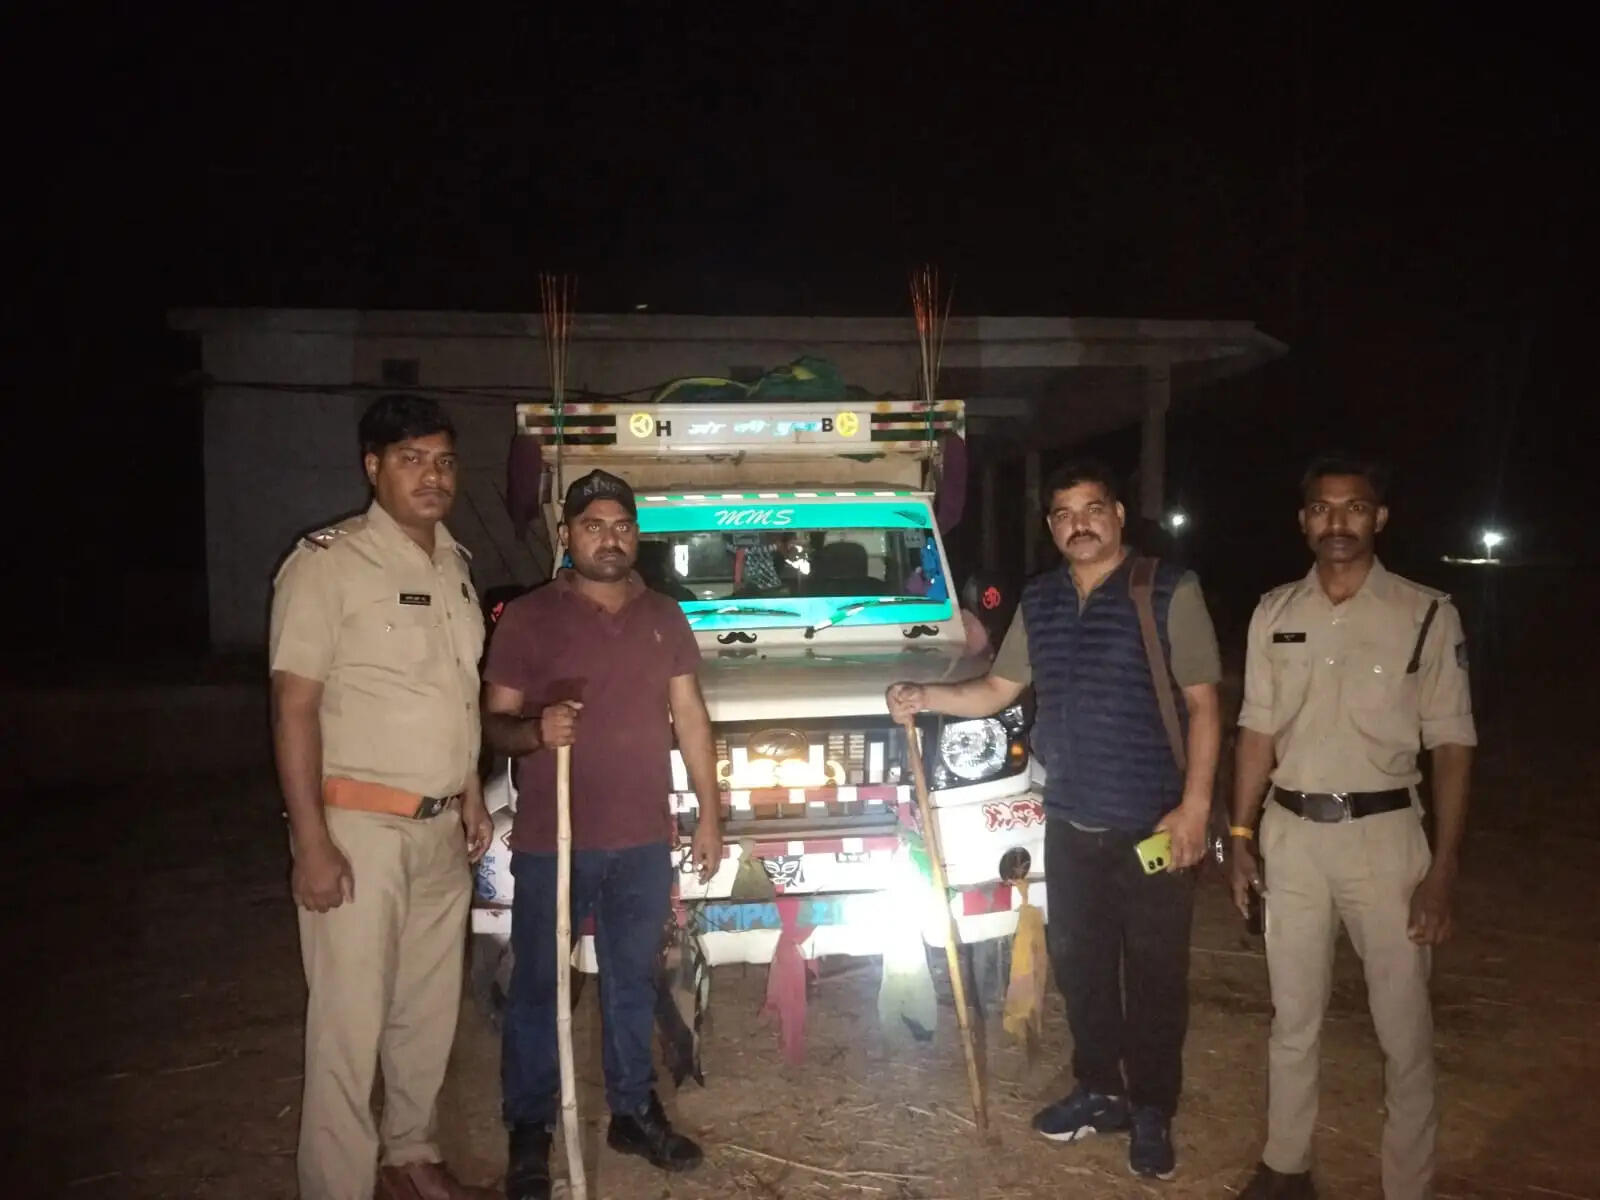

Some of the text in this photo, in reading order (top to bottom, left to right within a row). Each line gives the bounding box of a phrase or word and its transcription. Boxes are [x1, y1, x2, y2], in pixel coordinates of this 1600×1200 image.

[655, 420, 672, 437] H
[821, 417, 834, 433] B
[714, 508, 795, 527] MMS
